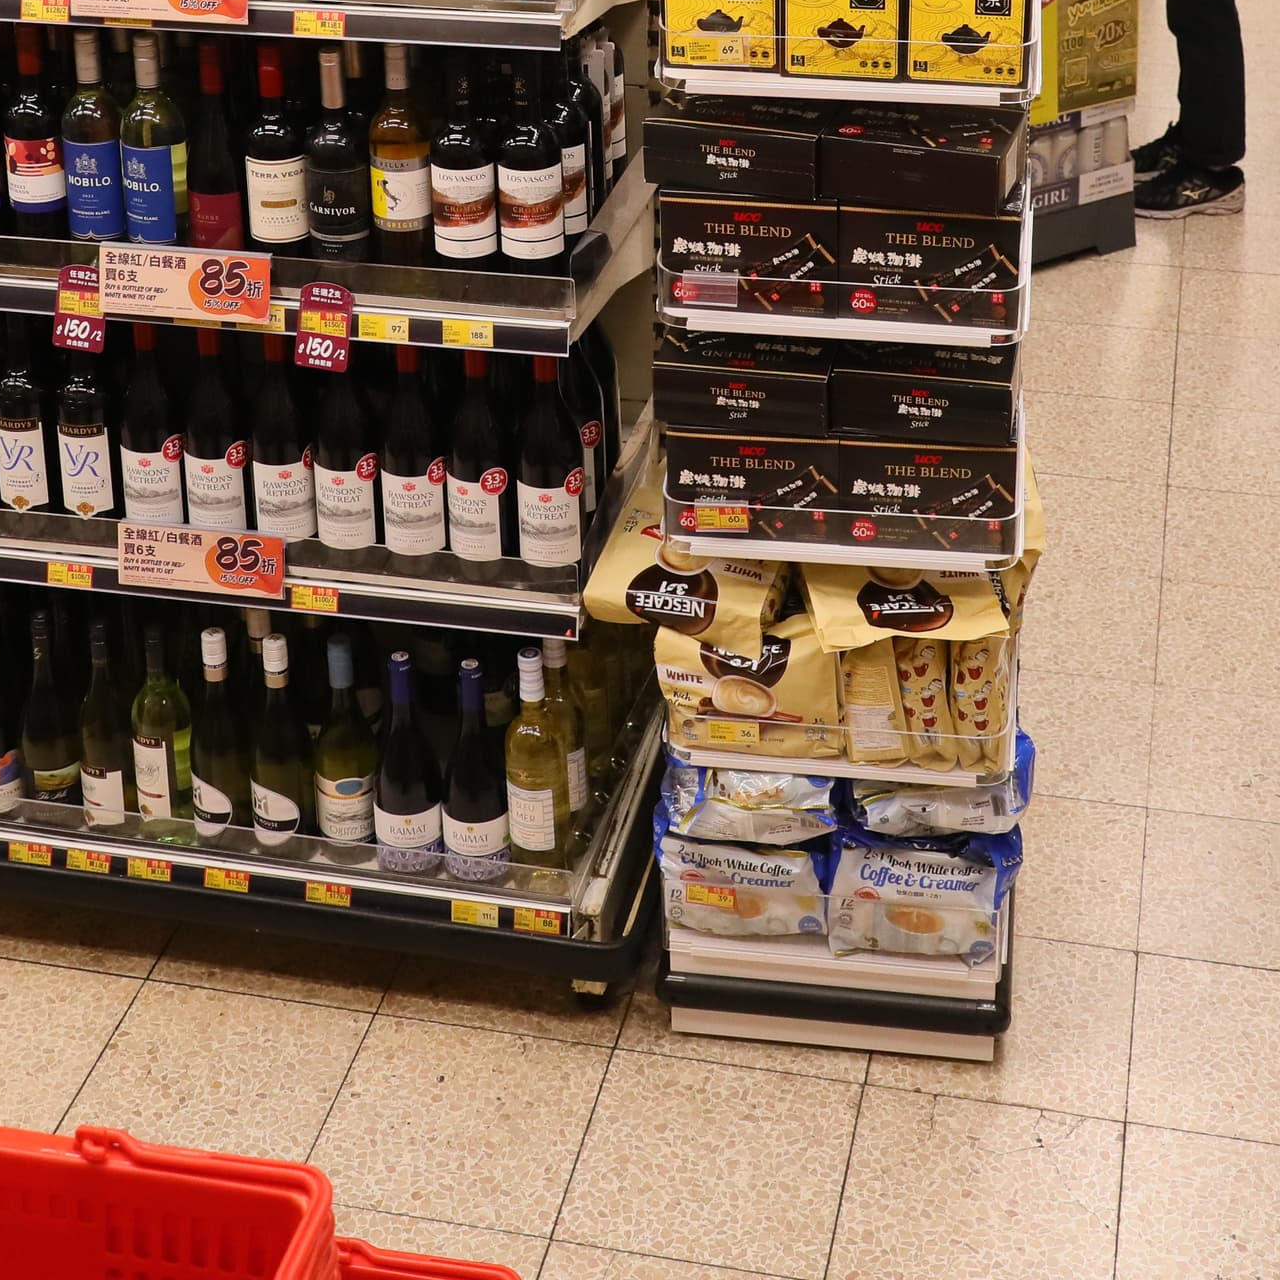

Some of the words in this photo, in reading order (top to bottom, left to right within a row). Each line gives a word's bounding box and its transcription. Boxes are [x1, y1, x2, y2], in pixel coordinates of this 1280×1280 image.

[704, 223, 736, 235] THE
[740, 224, 792, 238] BLEND
[885, 233, 918, 246] THE
[922, 234, 975, 249] BLEND
[885, 465, 917, 477] THE
[920, 465, 972, 479] BLEND
[723, 563, 762, 581] WHITE
[666, 668, 704, 684] WHITE
[723, 857, 758, 872] White
[760, 863, 792, 877] Coffee
[887, 854, 913, 872] Ipoh
[915, 857, 948, 874] White
[951, 861, 984, 876] Coffee
[731, 873, 795, 888] Creamer
[860, 864, 907, 887] Coffee
[919, 870, 980, 891] Creamer
